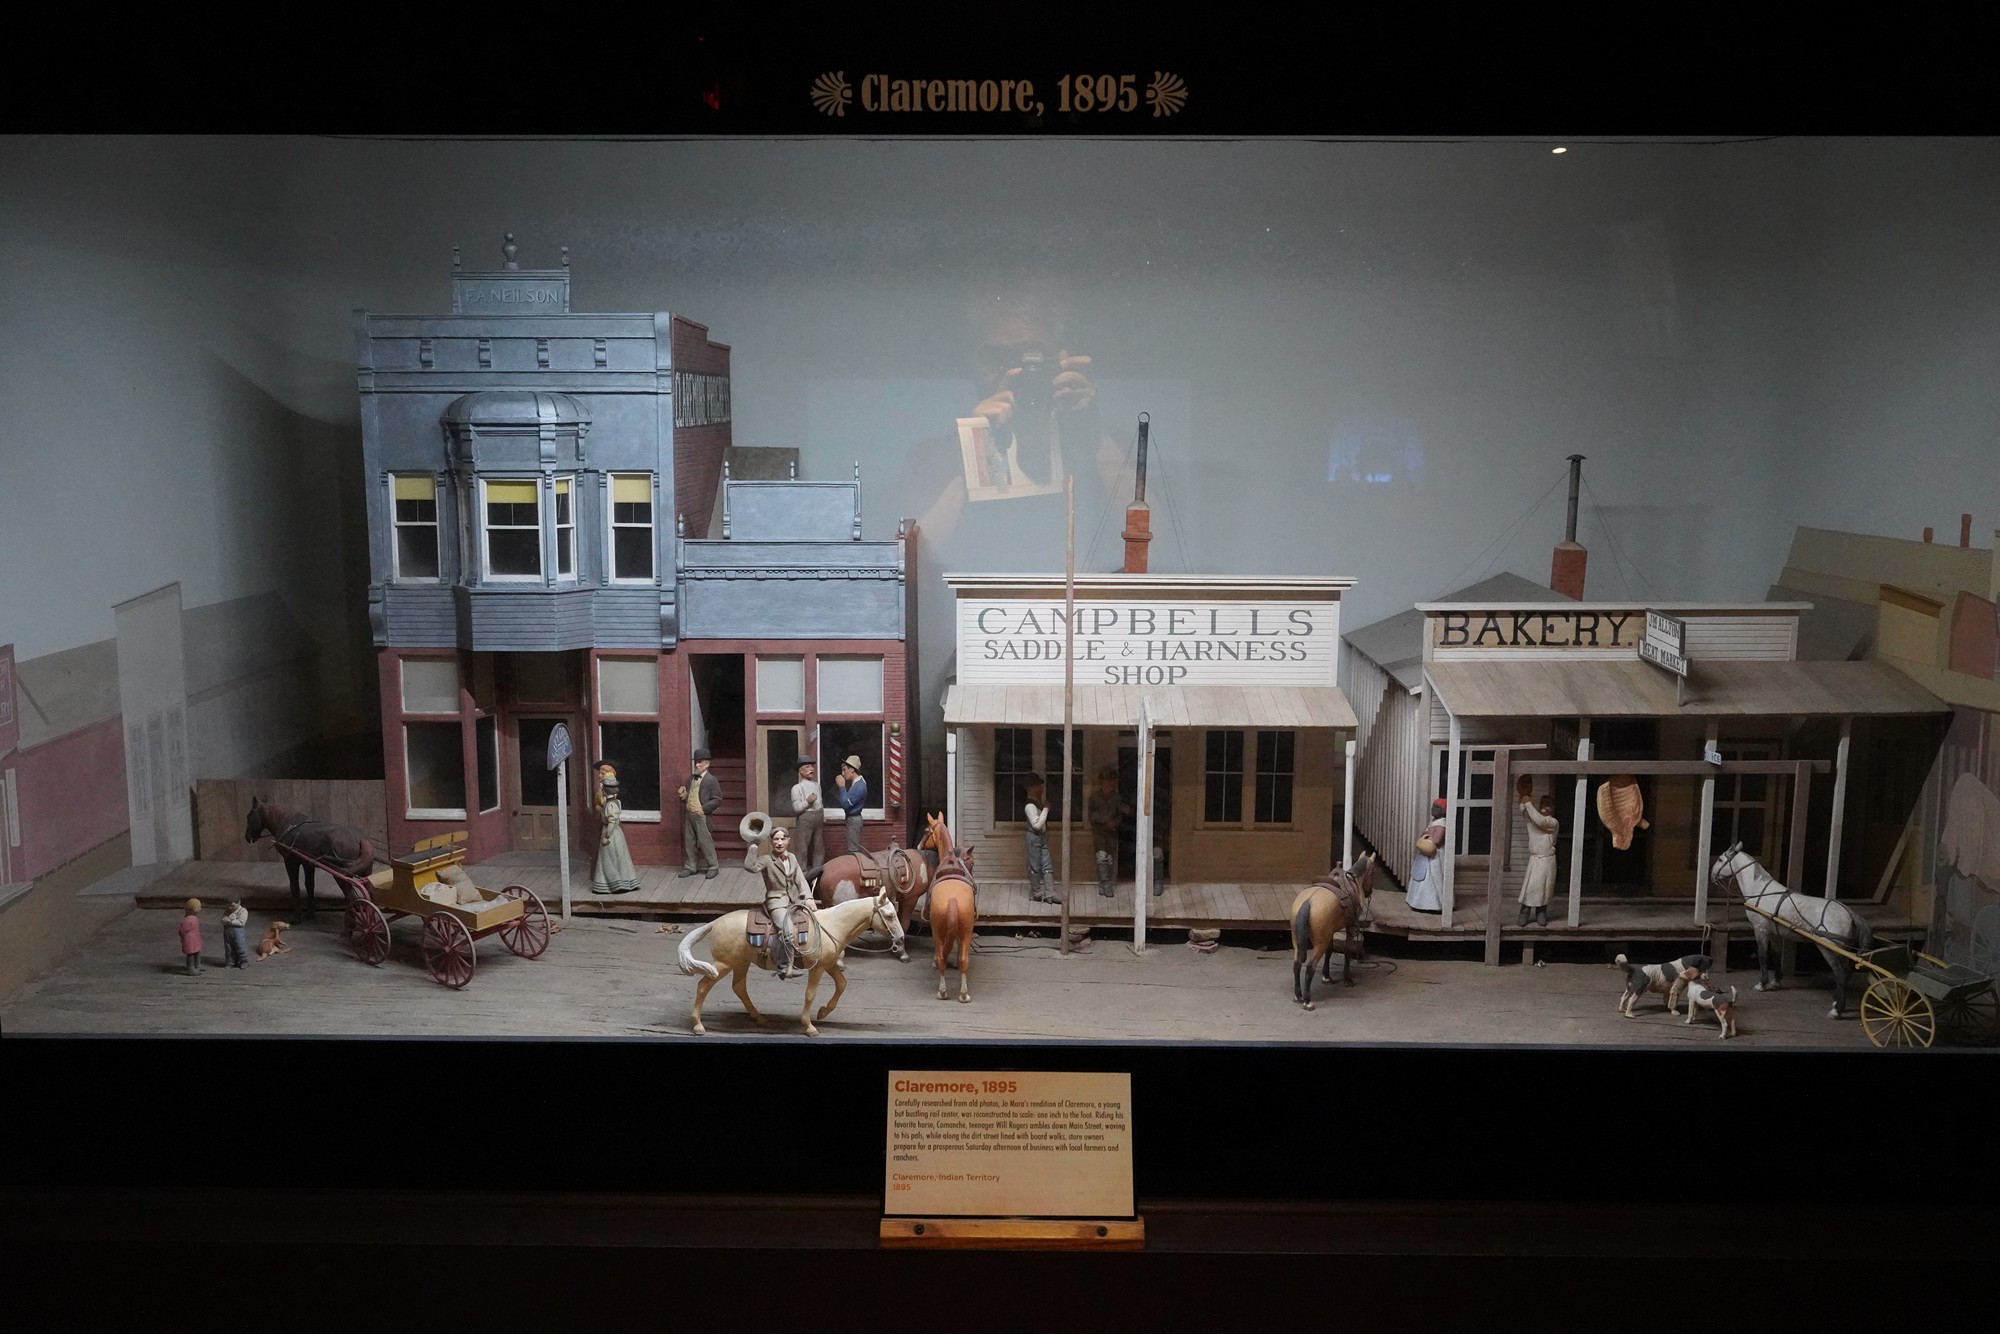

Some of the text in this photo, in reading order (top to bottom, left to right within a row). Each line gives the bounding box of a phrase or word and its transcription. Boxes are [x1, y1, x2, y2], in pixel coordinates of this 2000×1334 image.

[861, 74, 1138, 117] Claremore, 1895
[977, 607, 1315, 637] CAMPBELLS
[1121, 641, 1135, 657] &
[1145, 640, 1308, 661] HARNESS
[1642, 641, 1687, 674] MEAT MARKET
[1103, 665, 1188, 685] SHOP
[895, 1080, 1017, 1095] Claremore, 1895
[895, 1099, 920, 1109] Carefully
[922, 1099, 952, 1107] researched
[954, 1099, 967, 1107] from
[980, 1100, 1000, 1109] photos,
[1030, 1100, 1056, 1108] rendition
[1065, 1100, 1096, 1110] Claremore,
[1103, 1102, 1120, 1110] young
[906, 1110, 928, 1119] bustling
[930, 1110, 940, 1118] rail
[941, 1110, 959, 1119] center,
[1095, 1111, 1114, 1120] Riding
[936, 1121, 968, 1130] Comanche,
[969, 1122, 994, 1130] teenager
[1009, 1122, 1028, 1130] Rogers
[1085, 1122, 1103, 1131] Street,
[1105, 1122, 1125, 1131] waving
[911, 1132, 924, 1141] pals,
[926, 1132, 941, 1140] while
[943, 1132, 959, 1141] along
[961, 1132, 970, 1140] the
[966, 1143, 992, 1152] Saturday
[893, 1174, 936, 1182] Claremore,
